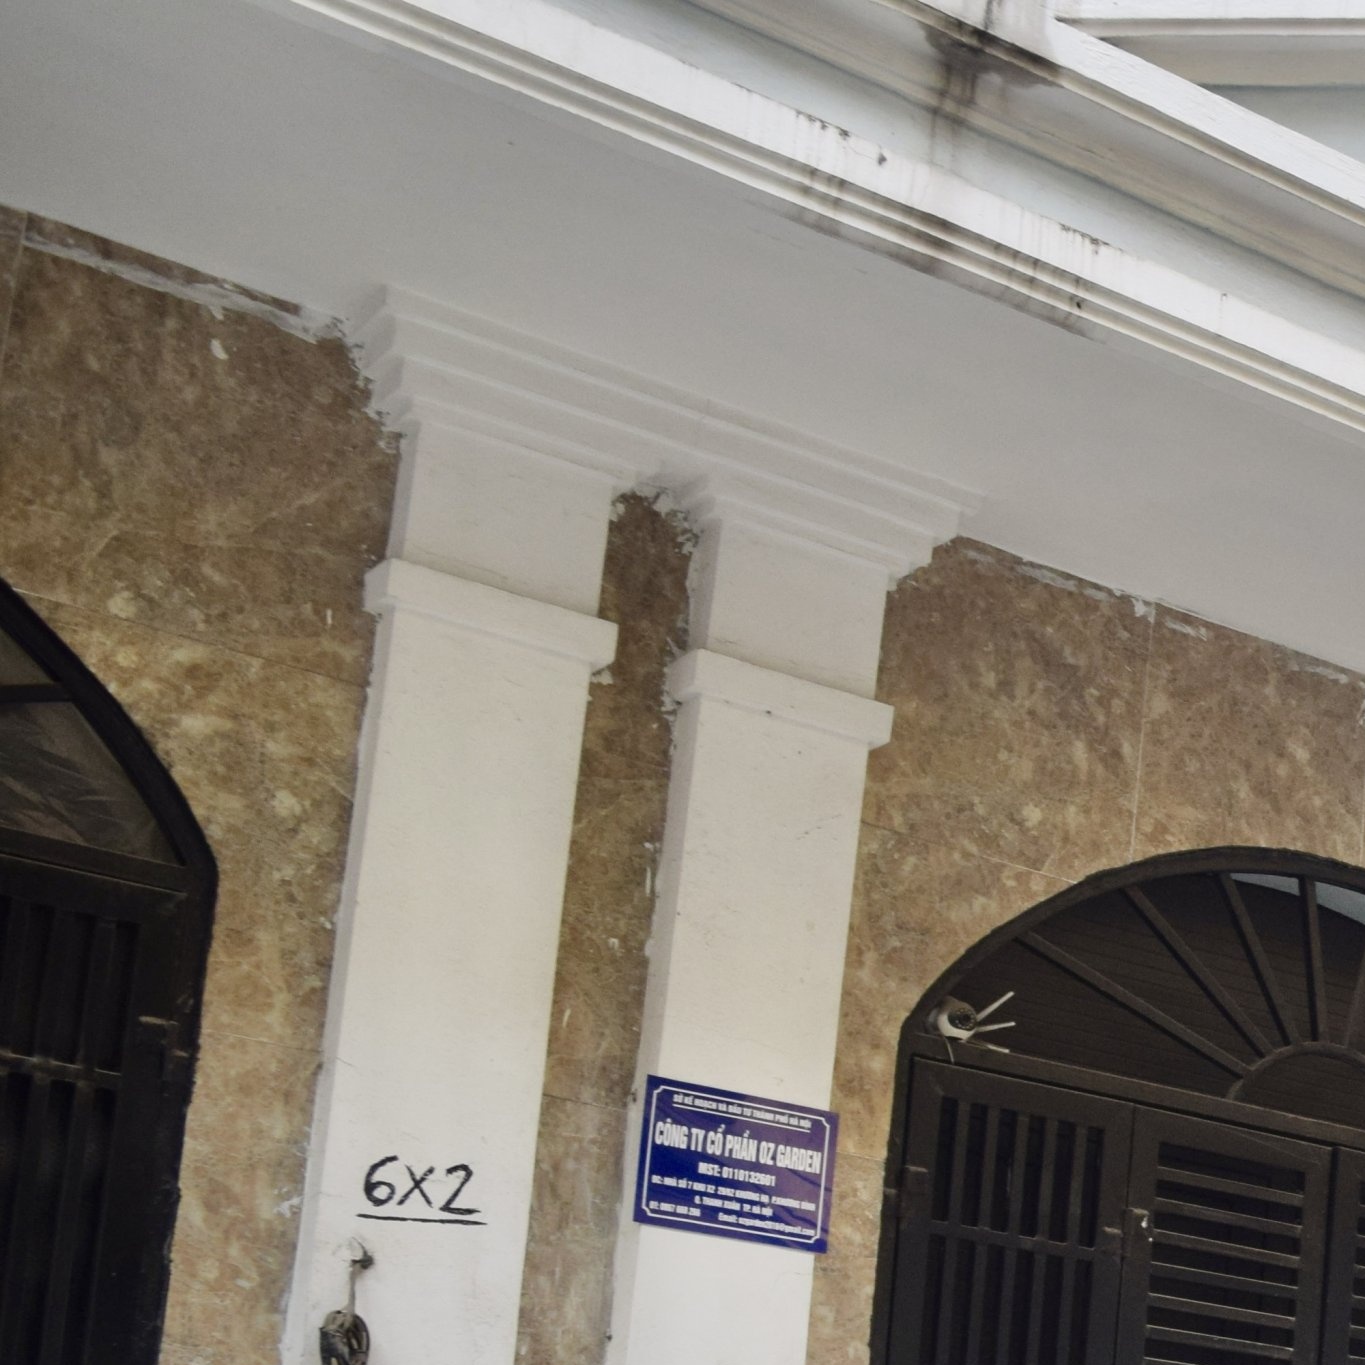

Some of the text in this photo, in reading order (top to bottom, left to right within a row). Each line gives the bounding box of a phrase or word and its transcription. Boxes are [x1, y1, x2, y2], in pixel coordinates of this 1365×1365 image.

[654, 1118, 822, 1174] CÔNG TY CỔ PHẦN OZ GARDEN
